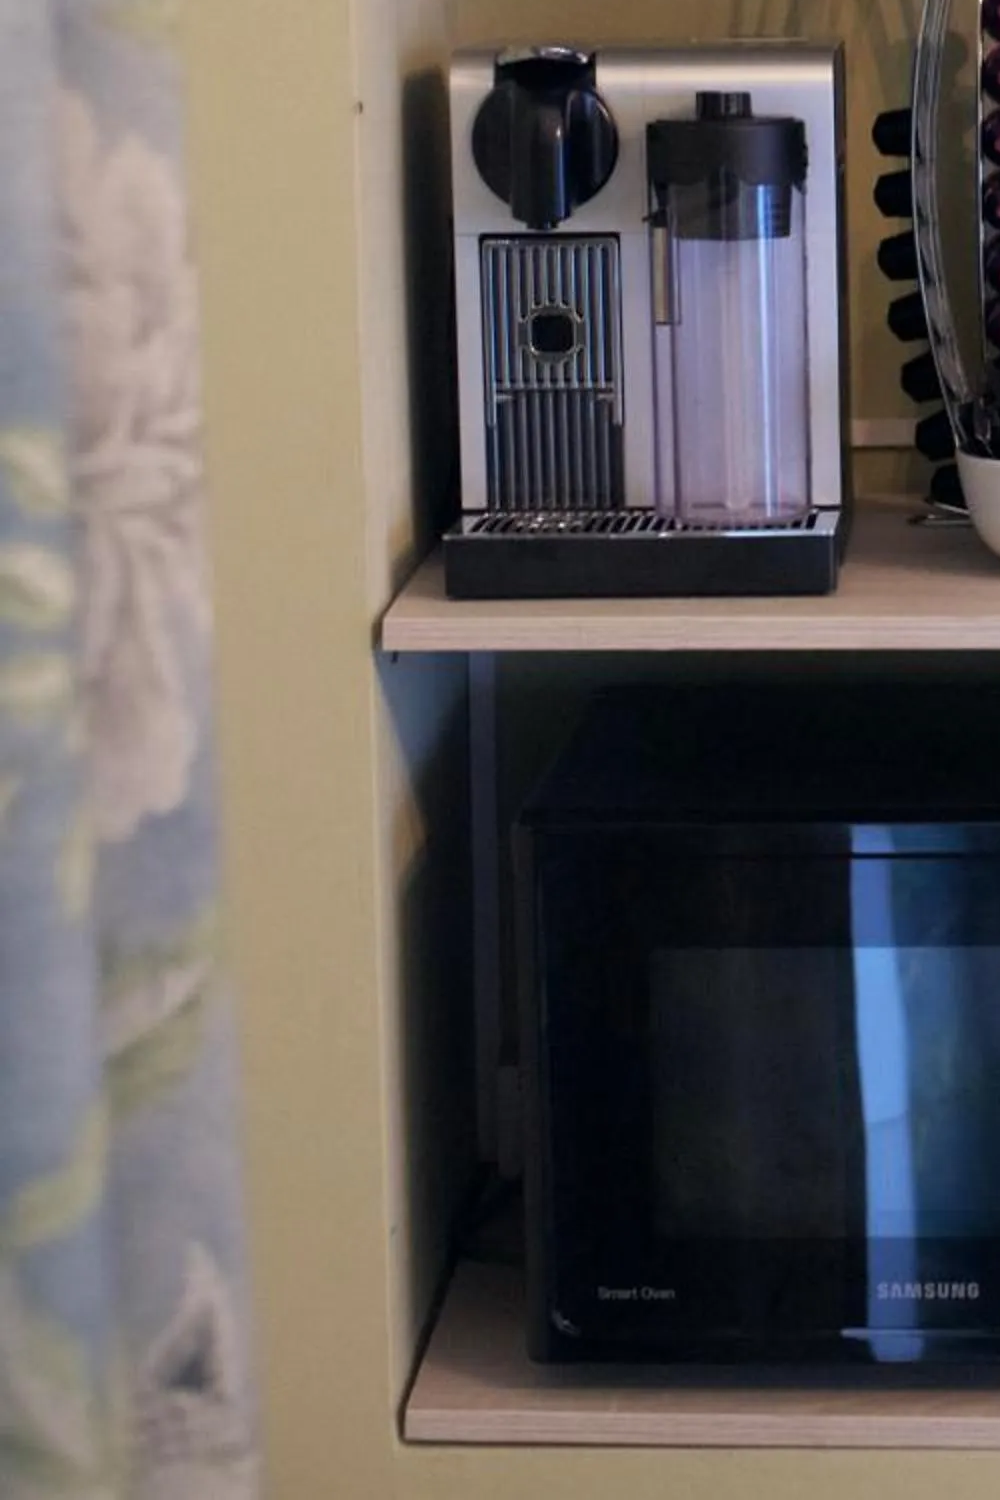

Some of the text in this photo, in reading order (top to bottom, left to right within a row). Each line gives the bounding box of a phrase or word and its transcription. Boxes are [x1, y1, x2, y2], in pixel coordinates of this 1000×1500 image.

[598, 1285, 676, 1300] Smart Oven
[876, 1281, 981, 1300] SAMSUNG
